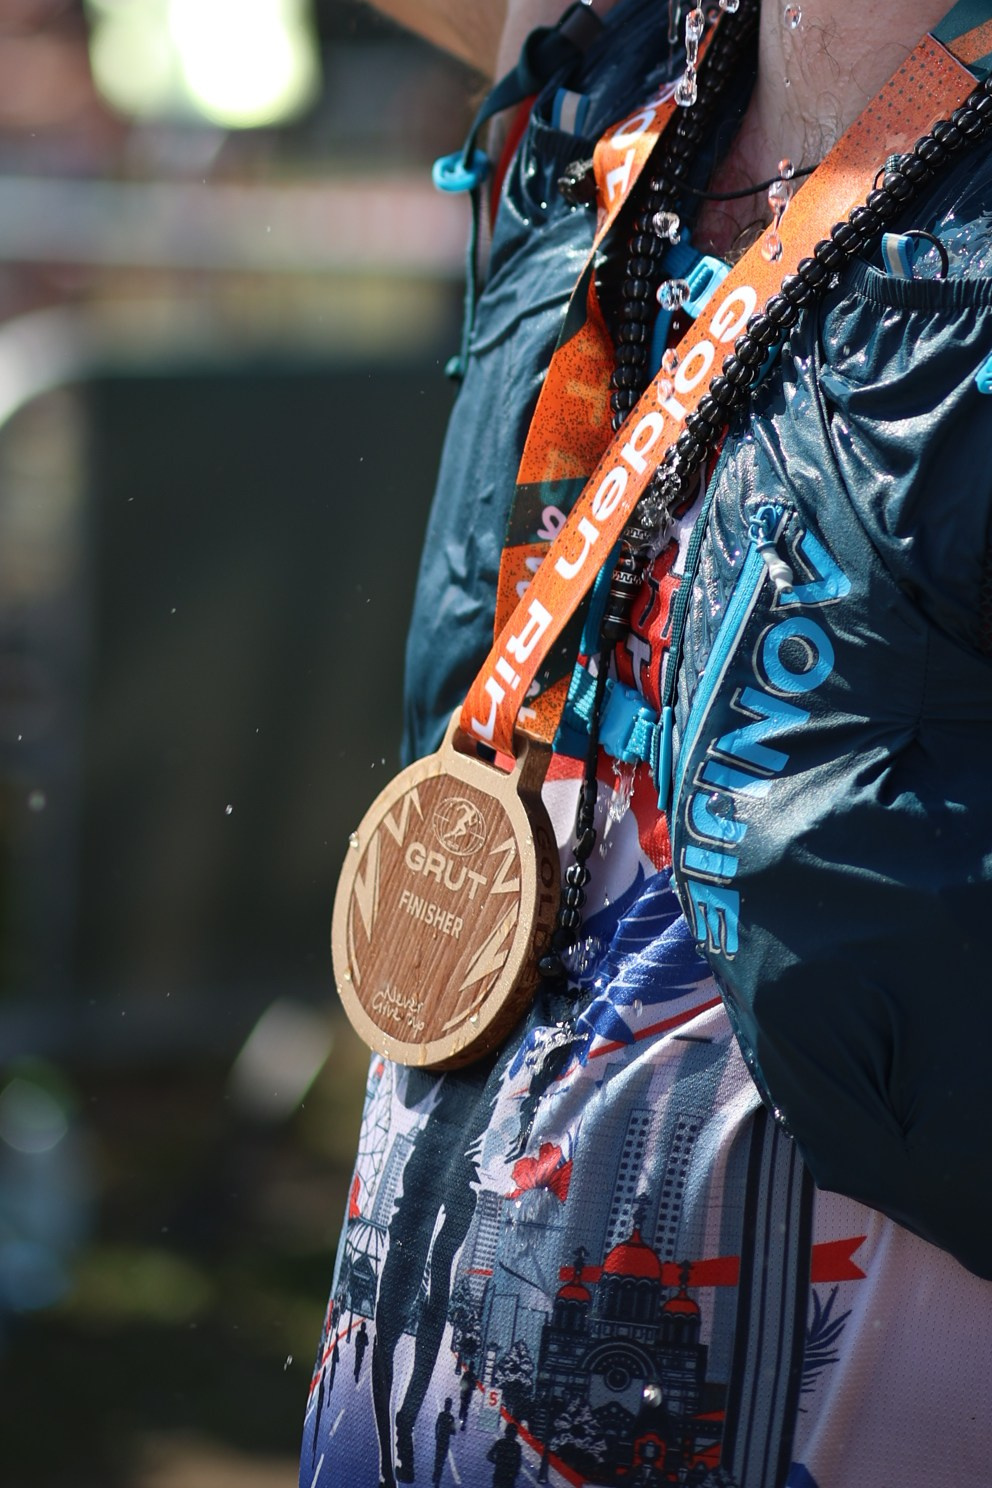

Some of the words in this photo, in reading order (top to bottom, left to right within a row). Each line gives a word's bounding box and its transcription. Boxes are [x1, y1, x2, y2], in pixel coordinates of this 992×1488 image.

[555, 284, 758, 581] Golden
[469, 601, 551, 741] Rin
[405, 844, 488, 900] GRUT
[399, 891, 464, 939] FINISHER
[372, 991, 402, 1022] Give
[383, 984, 425, 1014] Never
